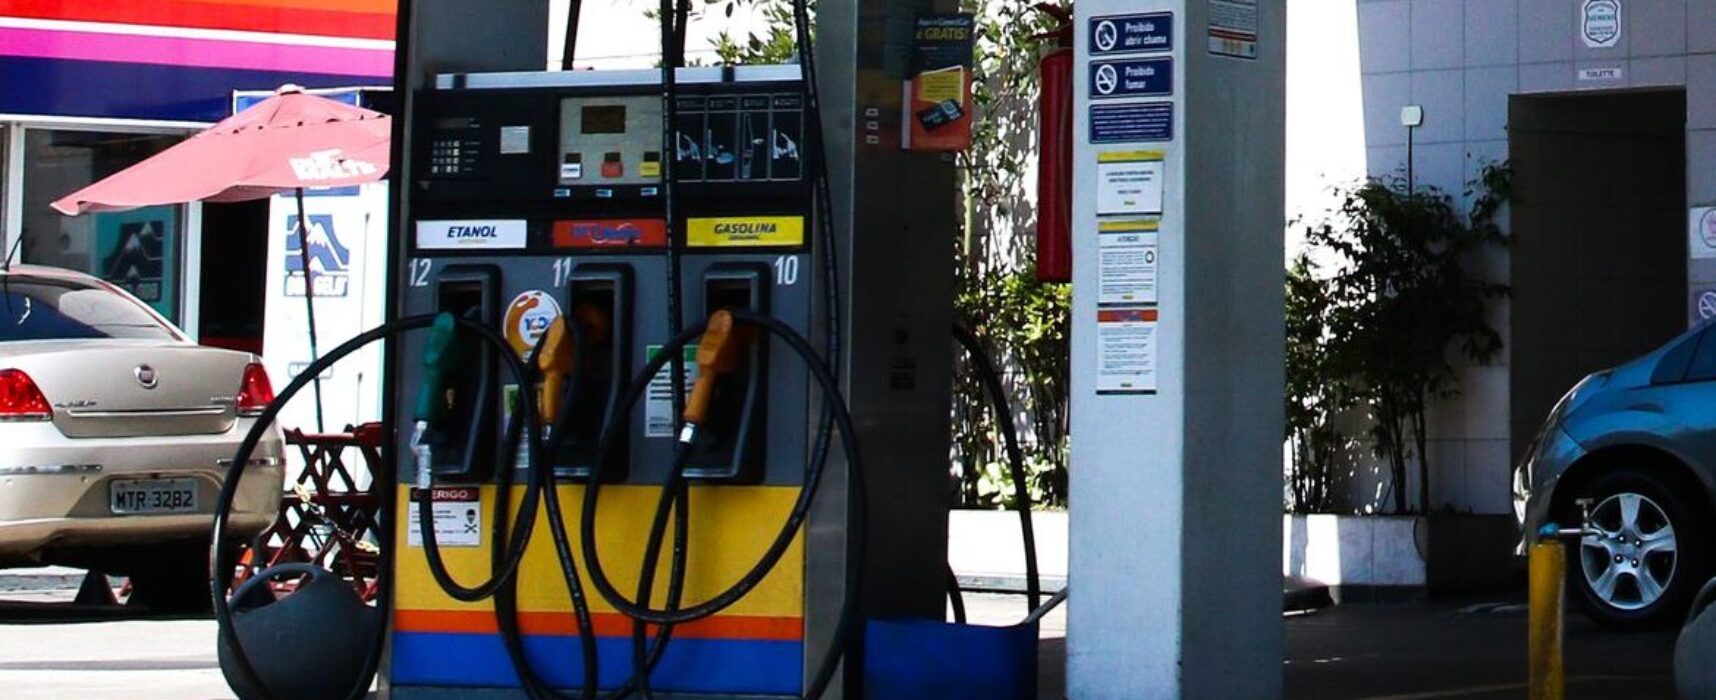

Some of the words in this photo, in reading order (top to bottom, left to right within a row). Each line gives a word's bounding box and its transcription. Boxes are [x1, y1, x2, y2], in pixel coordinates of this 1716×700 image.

[1125, 22, 1154, 33] Proibido
[1125, 36, 1141, 46] abrir
[1143, 35, 1167, 45] chama
[1125, 66, 1155, 77] Proibido
[1125, 79, 1146, 89] fumar
[447, 225, 498, 238] ETANOL
[714, 223, 777, 235] GASOLINA
[408, 258, 432, 287] 12
[552, 257, 572, 287] 11
[774, 255, 799, 285] 10
[424, 489, 468, 499] ERIGO
